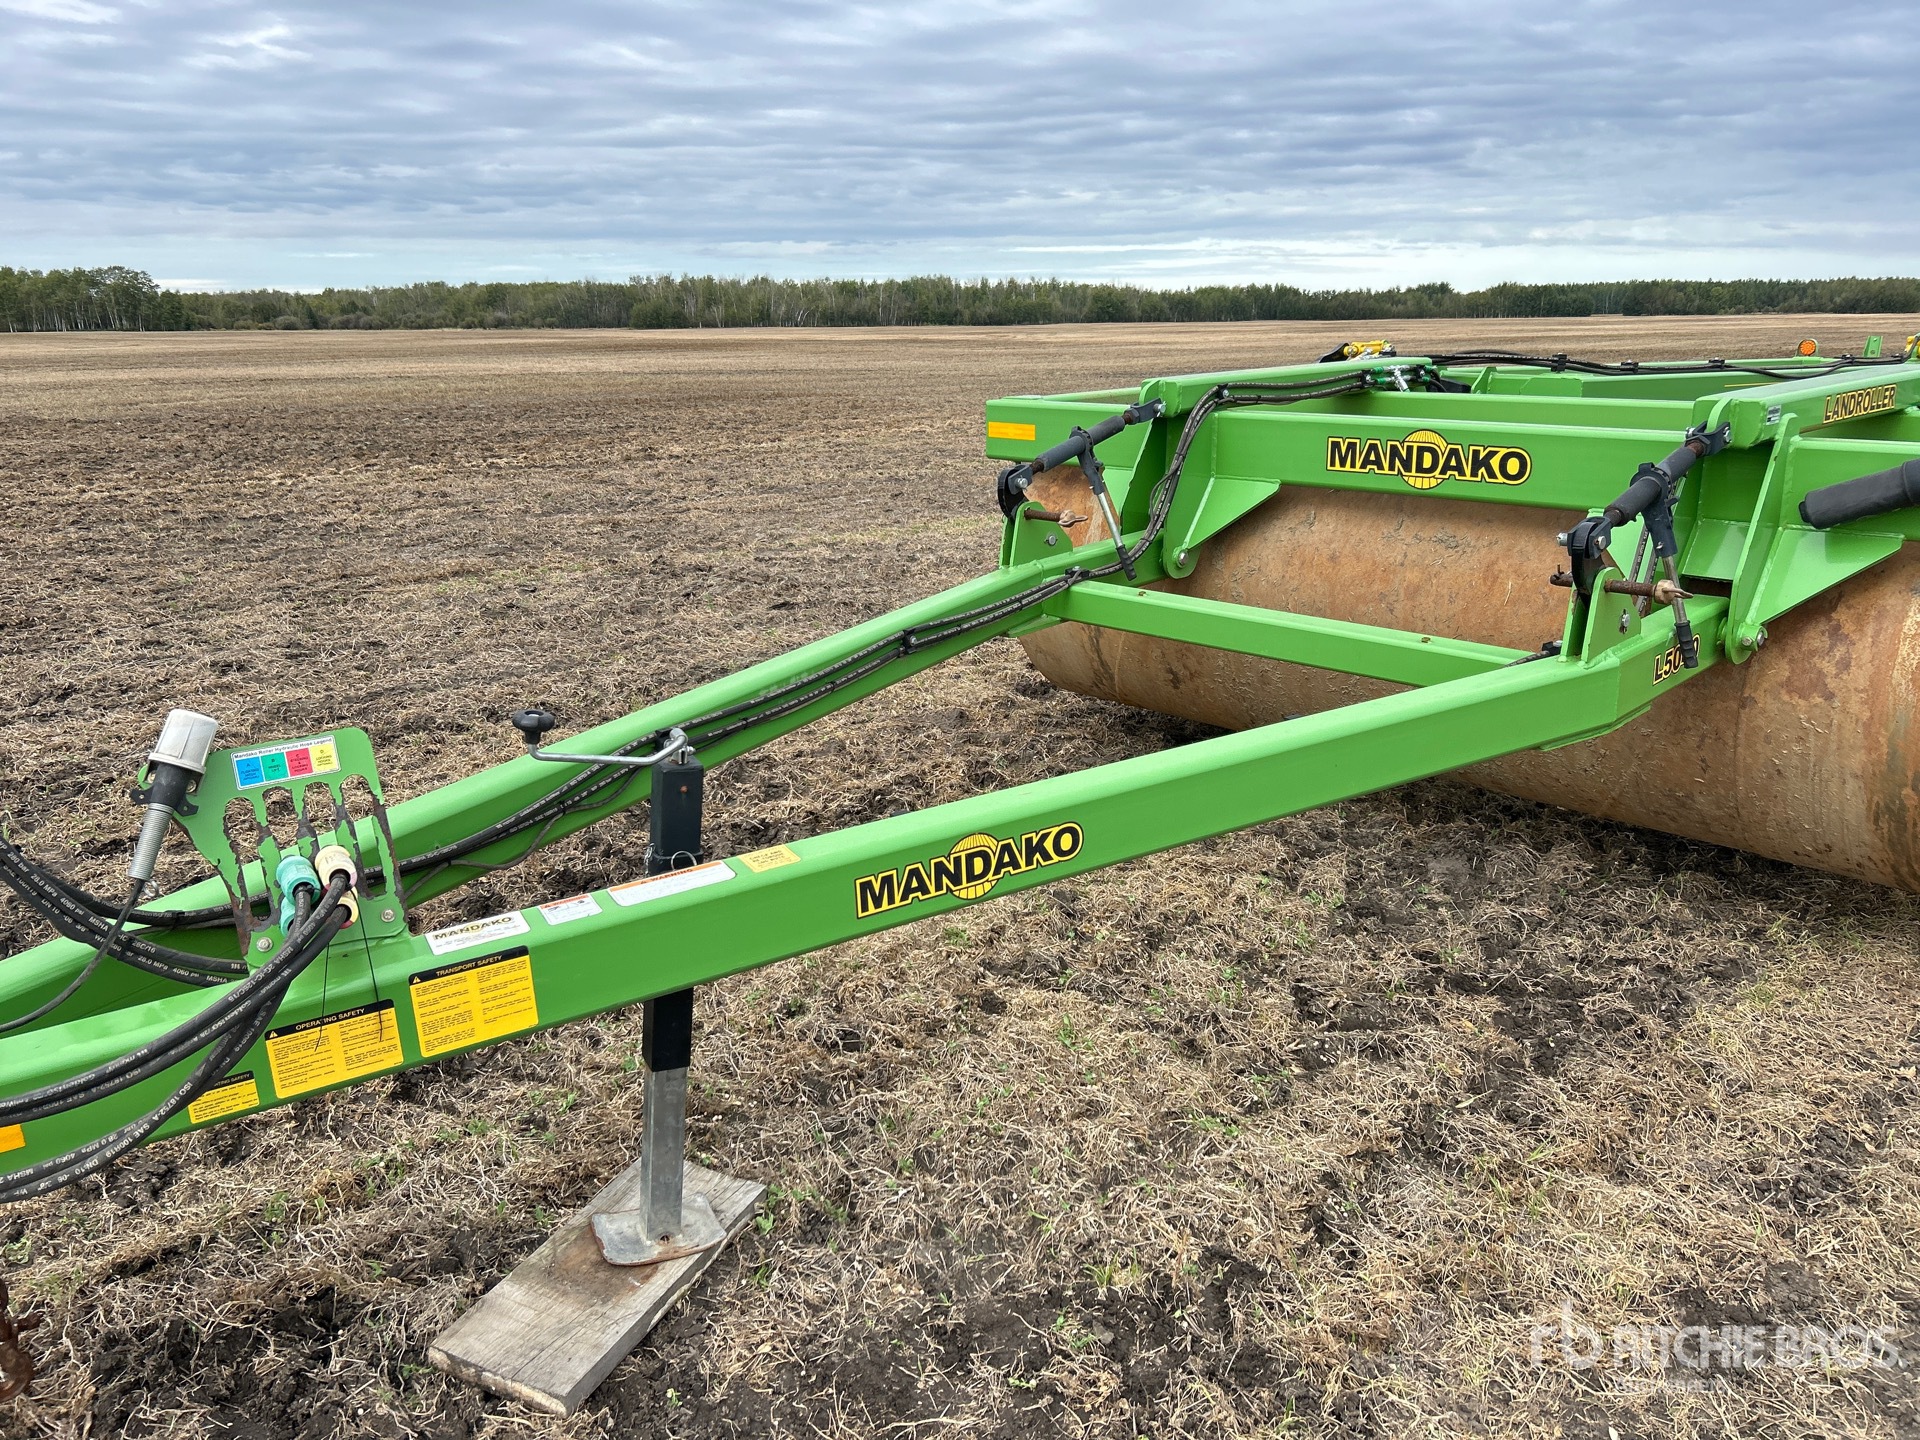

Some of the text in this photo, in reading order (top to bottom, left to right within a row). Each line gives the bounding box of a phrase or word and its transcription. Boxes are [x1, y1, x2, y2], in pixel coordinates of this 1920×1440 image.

[1823, 383, 1897, 424] LANDROLLER
[1326, 436, 1532, 485] MANDAKO
[234, 751, 258, 759] Mandako
[274, 744, 299, 752] Hydraulic
[313, 737, 333, 746] Legend
[855, 821, 1084, 919] MANDAKO
[7, 850, 21, 867] 280
[17, 859, 31, 874] bar
[30, 873, 45, 888] 28.0
[42, 883, 59, 898] MPa
[74, 907, 85, 916] psi
[88, 916, 109, 933] MSHA
[432, 916, 513, 940] MANDAKO
[273, 945, 294, 964] MSHA
[137, 954, 153, 965] 28.0
[153, 959, 169, 970] MPa
[206, 974, 228, 984] MSHA
[435, 955, 503, 977] TRANSPORT SAFETY
[338, 1008, 365, 1020] SAFETY
[178, 1081, 193, 1096] ISO
[152, 1096, 181, 1122] 18752-A
[100, 1133, 119, 1146] 28.0
[132, 1123, 150, 1139] SAE
[81, 1142, 100, 1153] MPa
[105, 1136, 134, 1158] 100R19
[55, 1153, 76, 1165] 4060
[7, 1168, 34, 1181] MSHA
